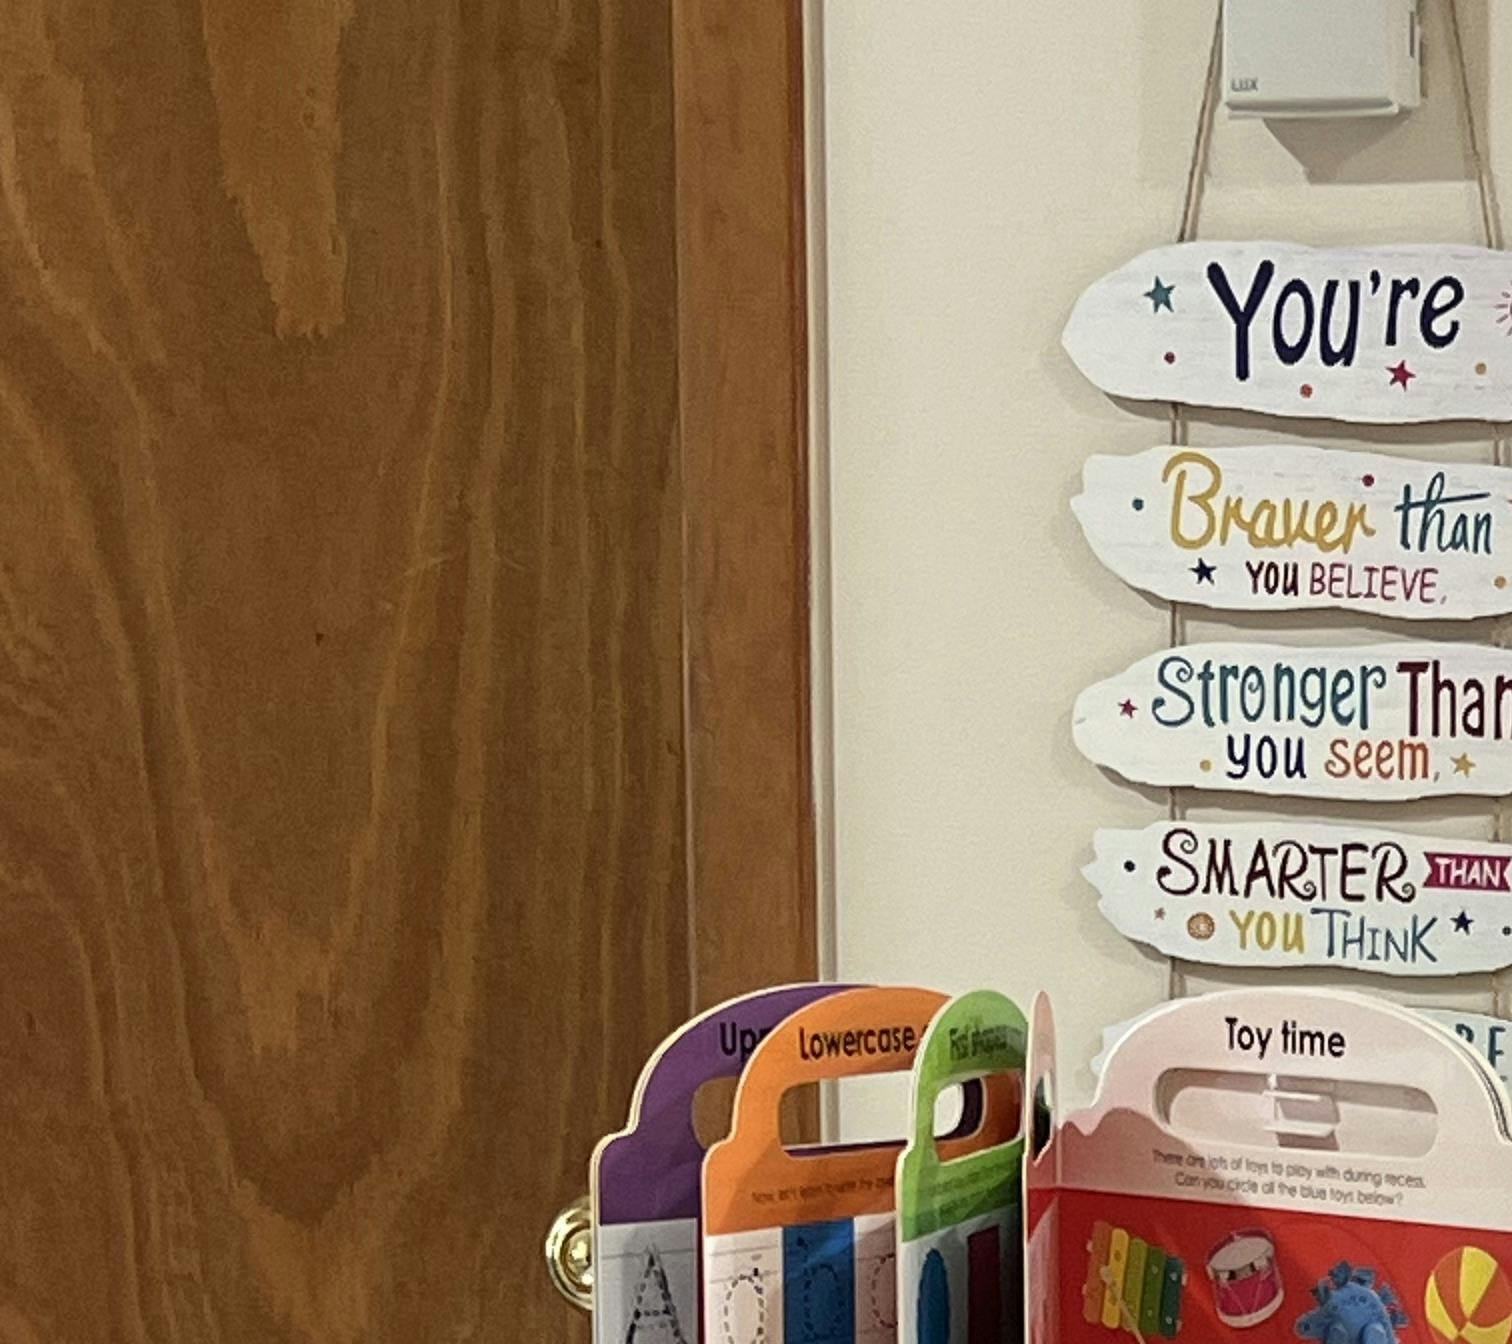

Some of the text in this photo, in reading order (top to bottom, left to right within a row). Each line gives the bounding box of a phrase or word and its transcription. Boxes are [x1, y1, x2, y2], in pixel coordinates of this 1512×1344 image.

[1231, 78, 1258, 91] LUX
[1207, 260, 1465, 381] You're
[1162, 452, 1492, 553] Braver than
[1246, 562, 1298, 596] YOU
[1150, 656, 1387, 729] Stronger
[1226, 733, 1306, 780] you
[1157, 828, 1500, 903] SMARTER THAN
[1230, 908, 1438, 963] YOU THINK
[800, 1026, 916, 1060] Lowercase
[1225, 1016, 1346, 1057] Toy time
